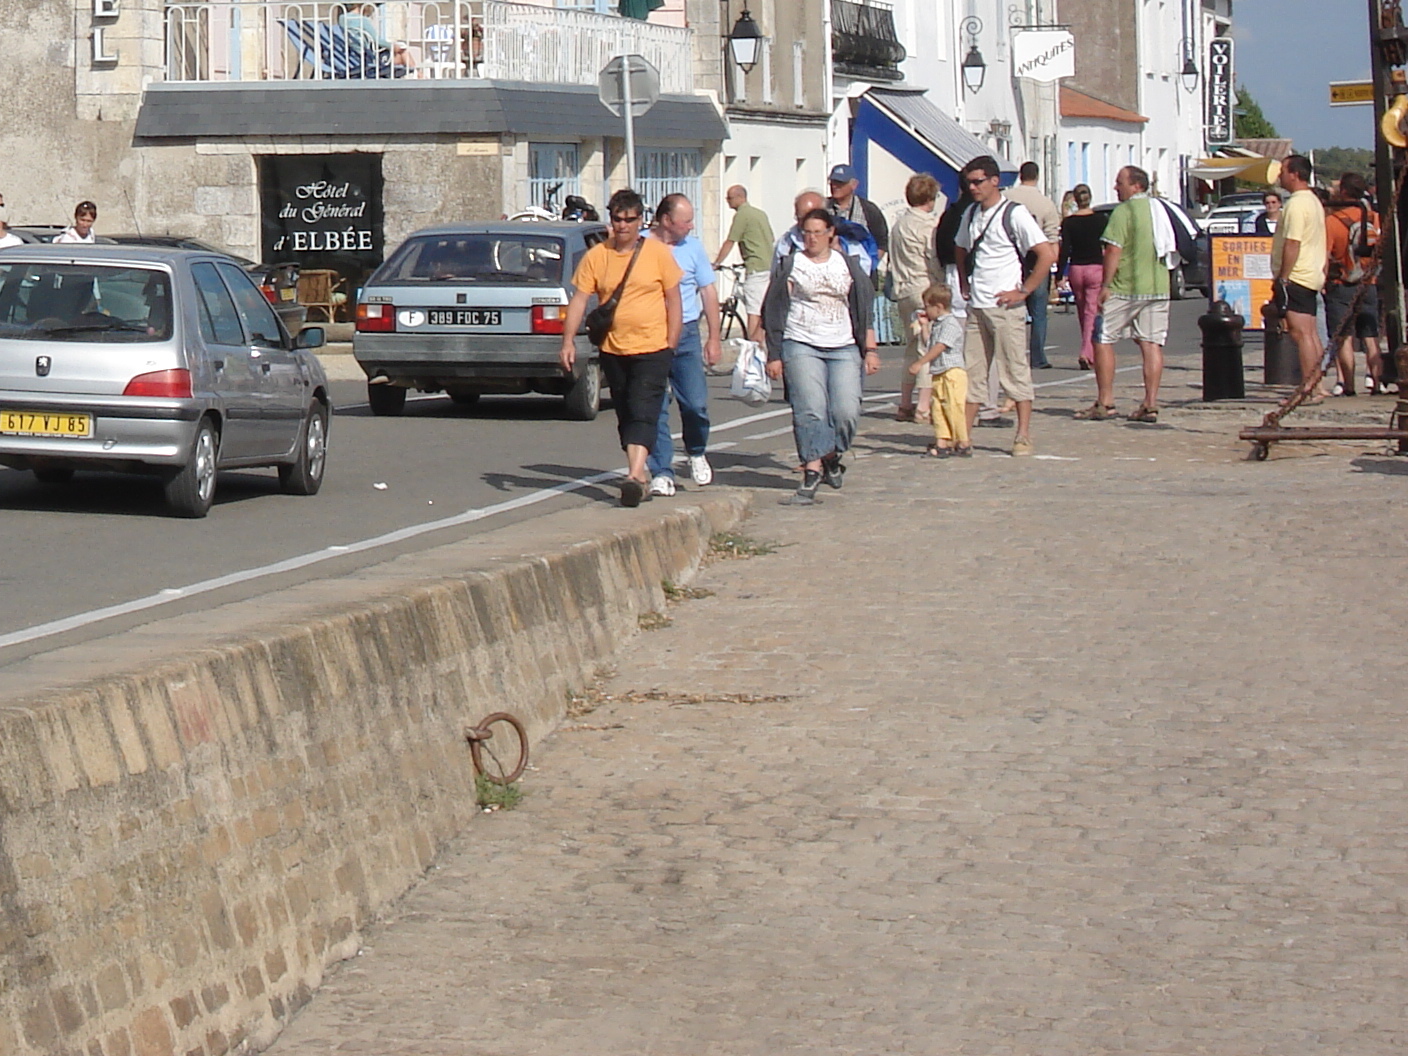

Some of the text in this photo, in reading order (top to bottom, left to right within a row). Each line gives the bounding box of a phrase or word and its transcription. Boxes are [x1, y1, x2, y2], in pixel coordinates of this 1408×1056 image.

[1212, 44, 1228, 126] VOILERIE
[295, 180, 350, 198] Hôtel
[278, 201, 366, 223] du Général
[1222, 241, 1266, 252] SORTIES
[1228, 254, 1240, 264] EN
[1218, 266, 1239, 277] MER
[408, 311, 416, 324] F
[430, 311, 453, 325] 389
[484, 311, 499, 325] 75
[8, 413, 85, 433] 617 VJ 85
